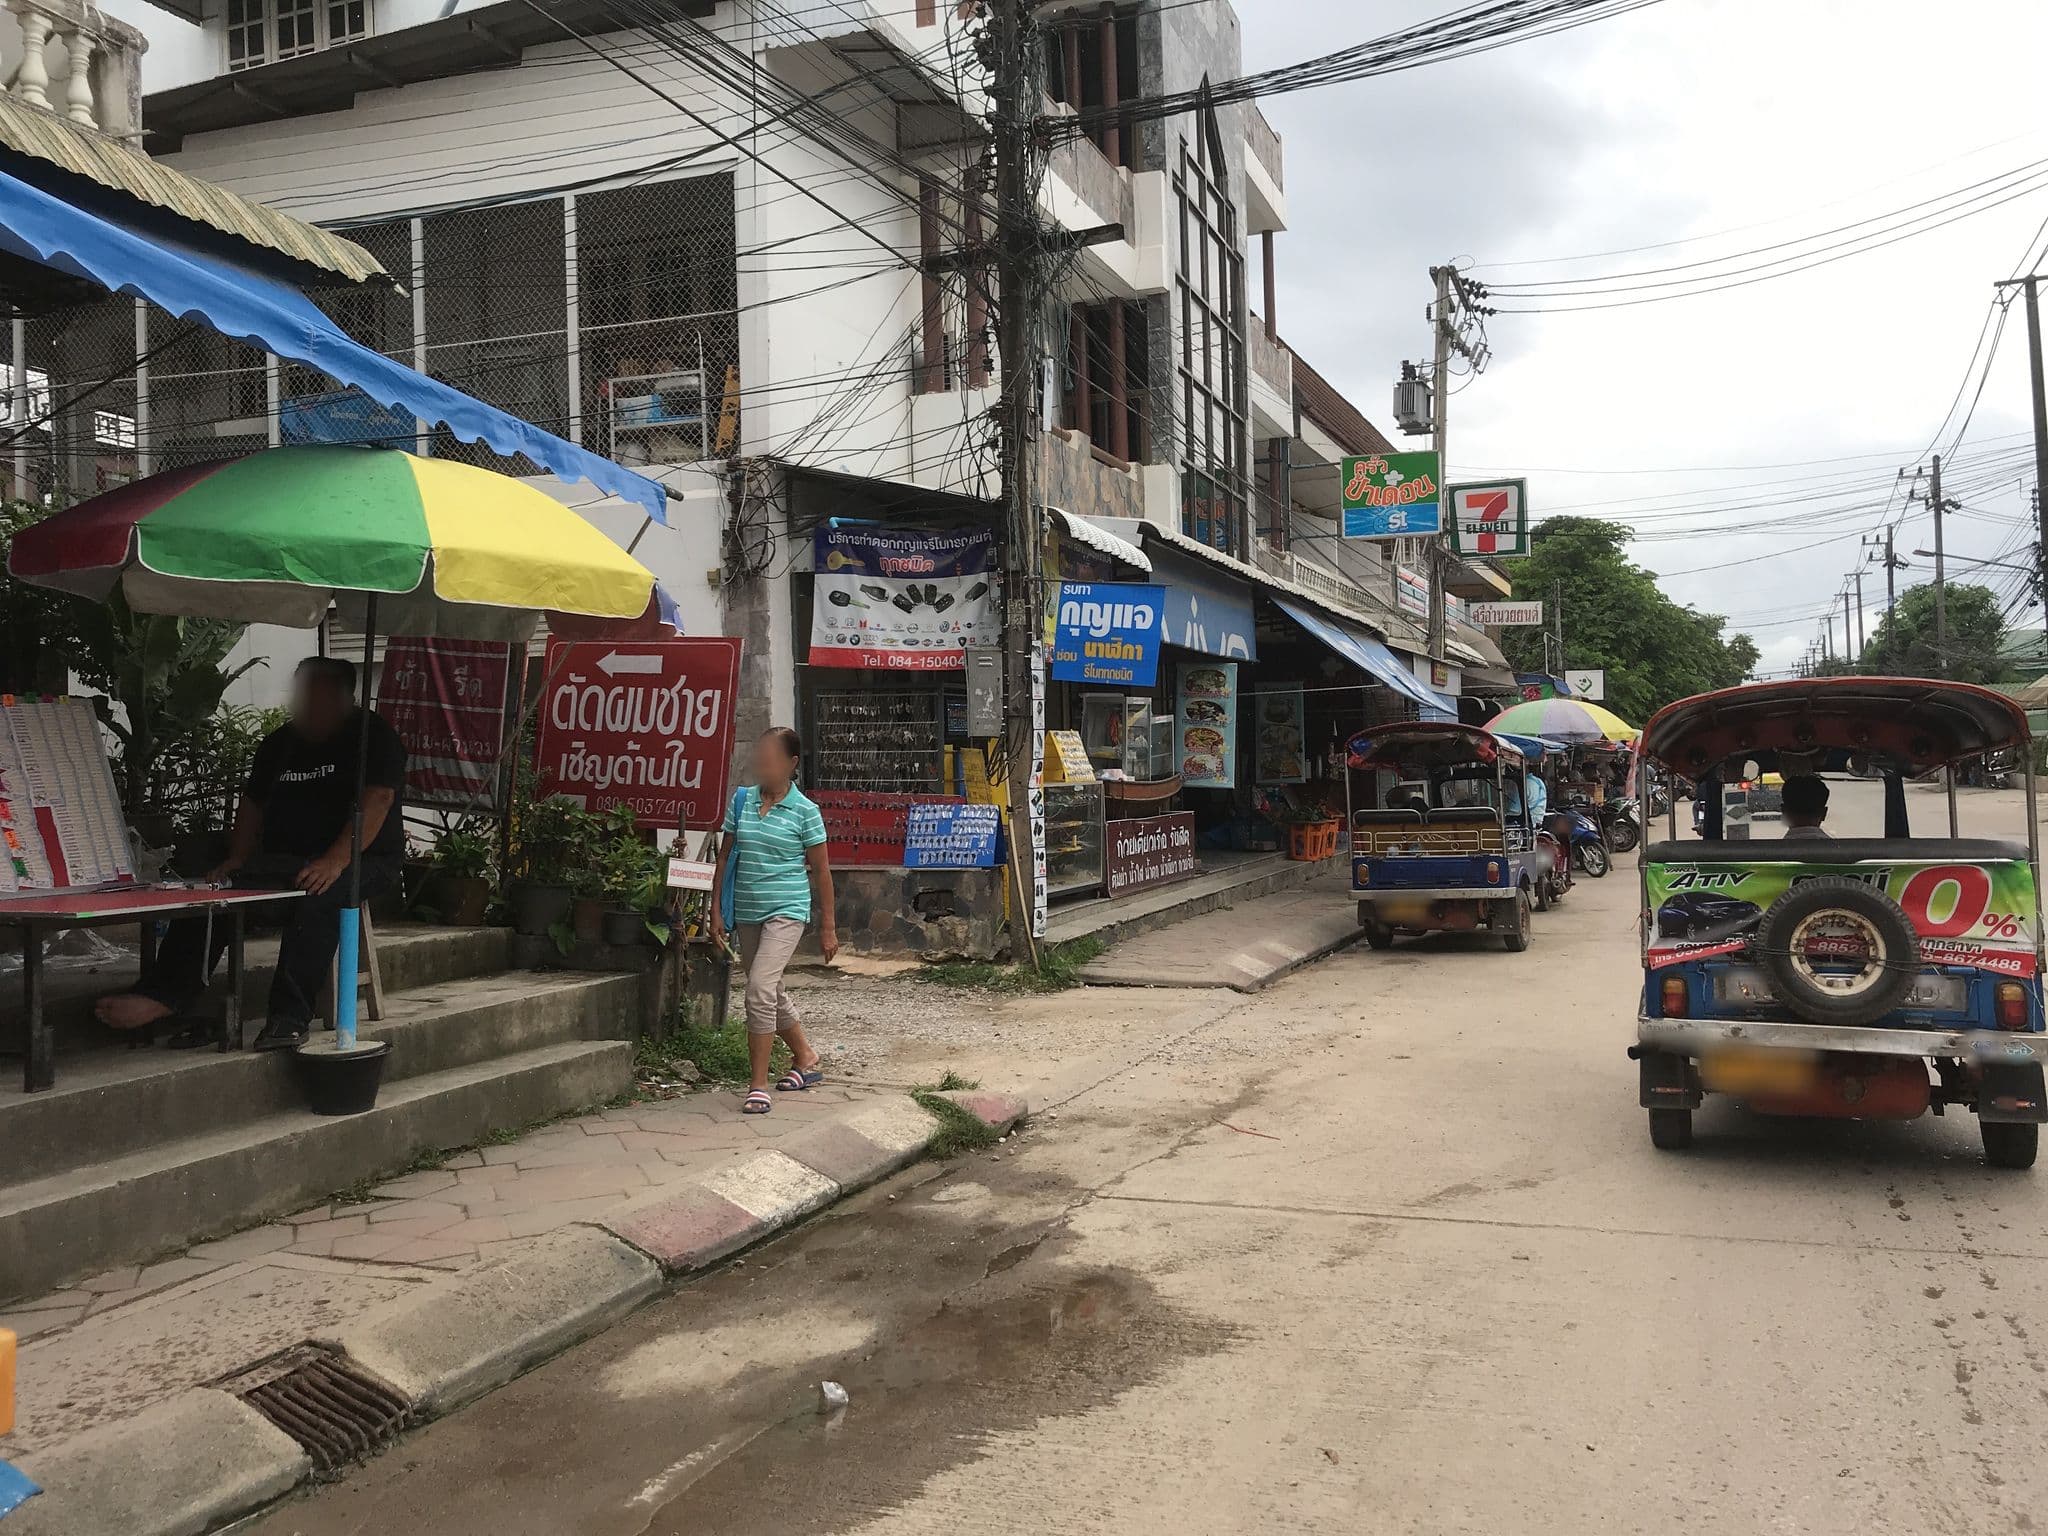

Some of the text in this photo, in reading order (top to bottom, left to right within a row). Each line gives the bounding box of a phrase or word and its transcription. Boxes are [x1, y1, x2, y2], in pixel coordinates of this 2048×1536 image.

[1354, 455, 1388, 476] ครัว
[1465, 490, 1509, 553] 7
[879, 553, 936, 577] ทุกชนิด
[1060, 600, 1154, 638] กุญแจ
[863, 654, 884, 667] Tel.
[1056, 648, 1077, 662] ซ่อม
[1084, 636, 1144, 661] นาฬิกา
[552, 672, 722, 738] ตัดผมชาย
[559, 739, 704, 790] เชิญด้านใน
[1666, 871, 1757, 890] ATIV
[1922, 937, 1983, 955] ทุกสาขา
